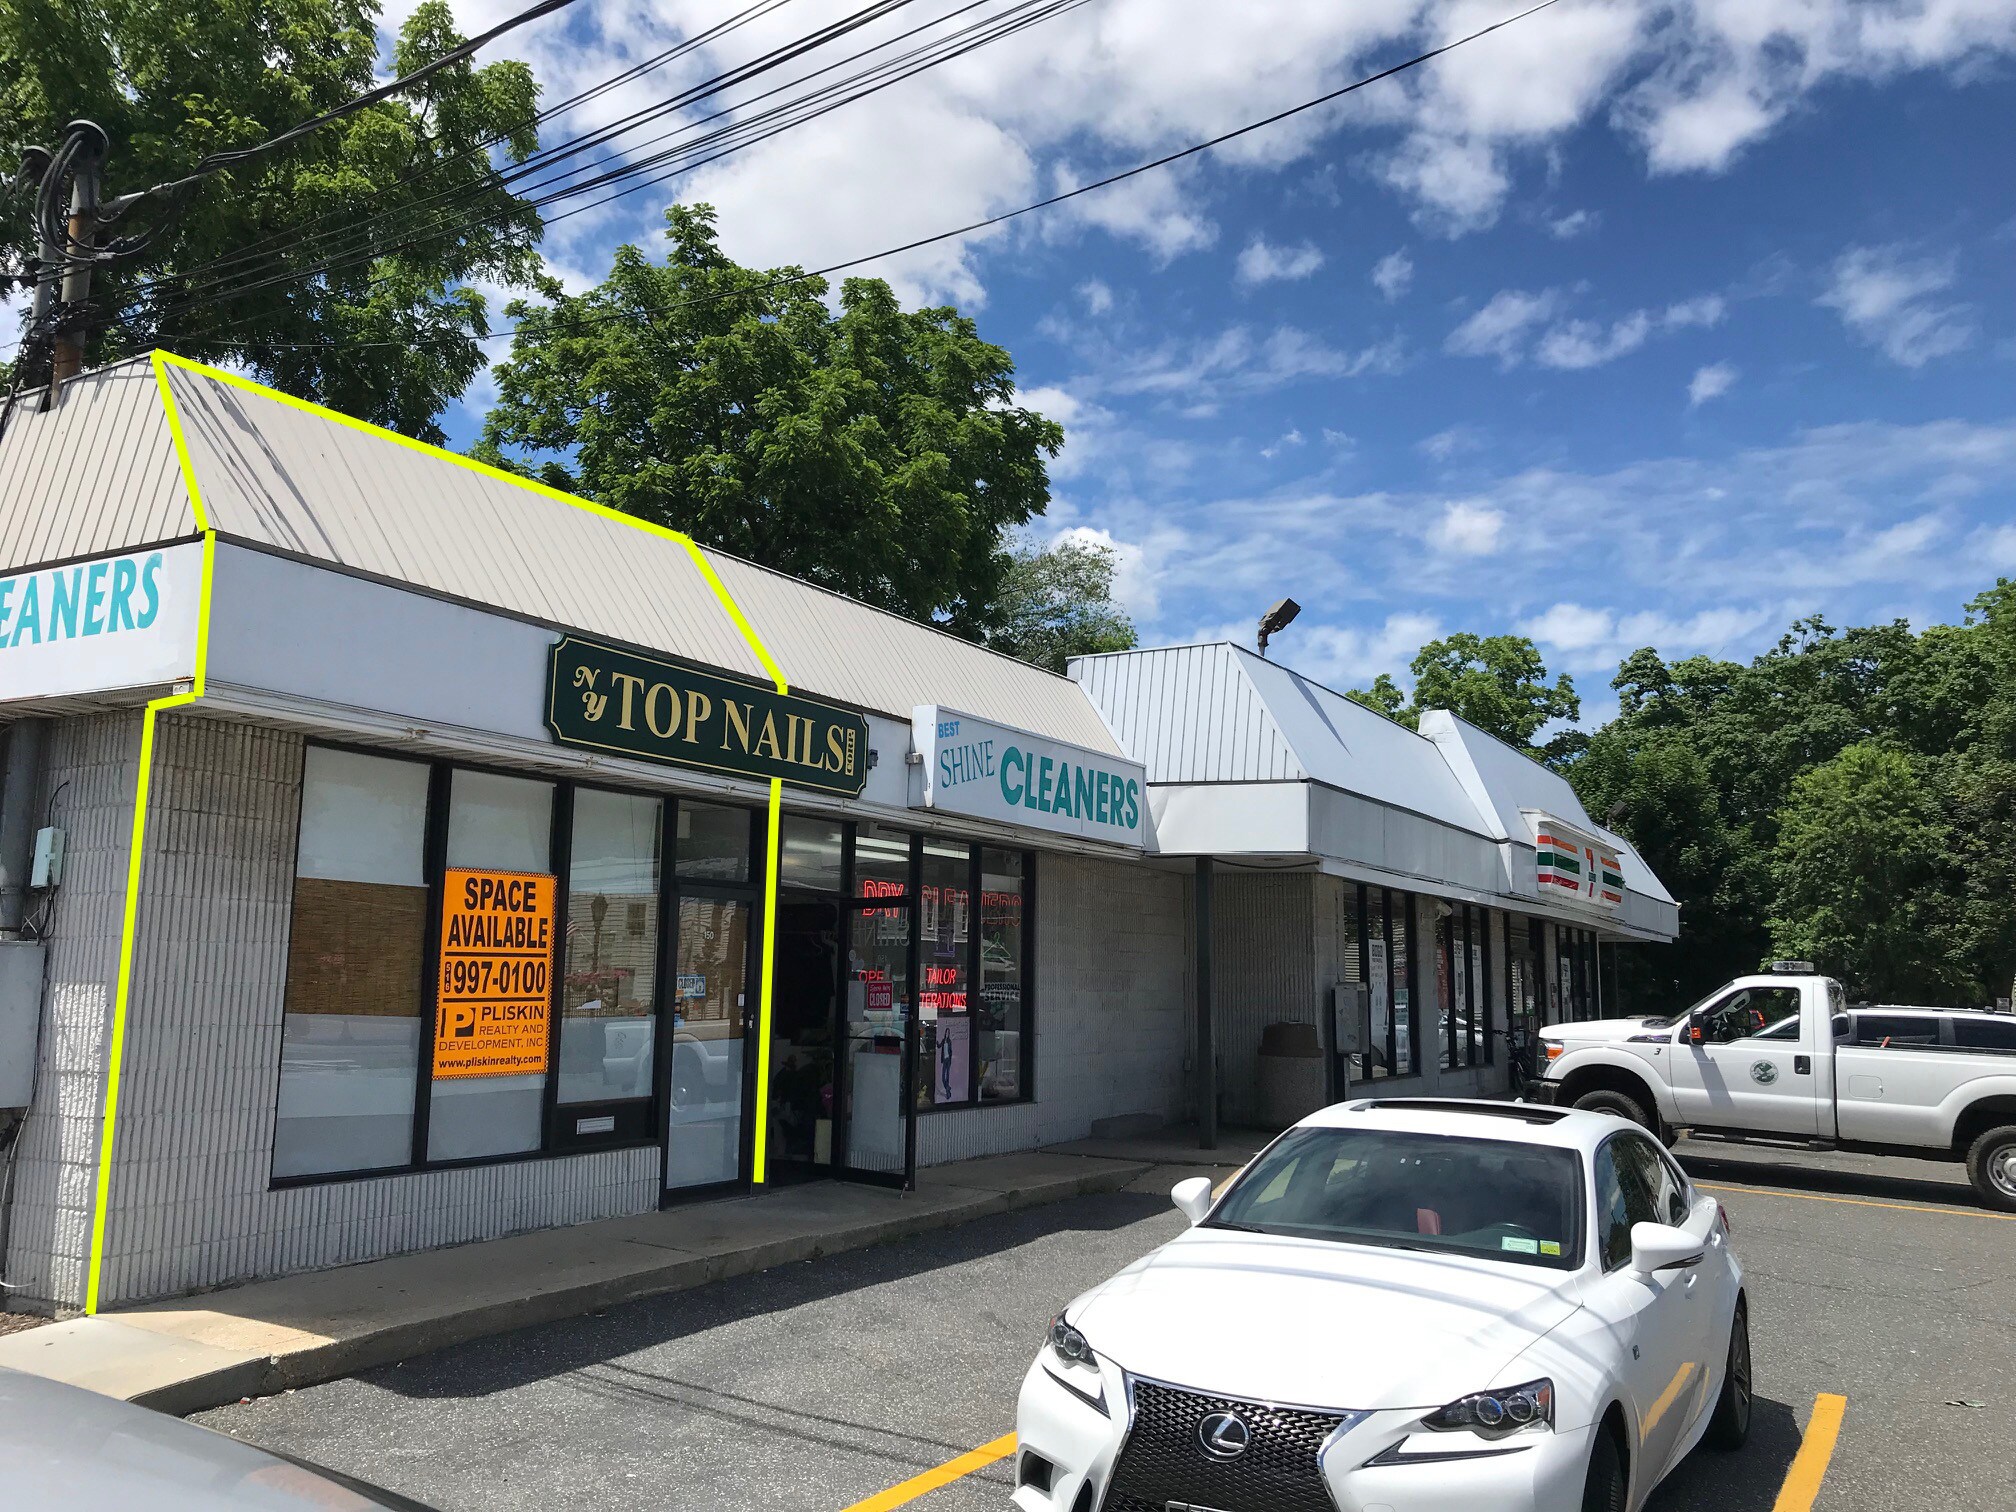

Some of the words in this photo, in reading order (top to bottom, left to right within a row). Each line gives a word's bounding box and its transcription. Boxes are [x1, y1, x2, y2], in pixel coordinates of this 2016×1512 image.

[611, 672, 712, 744] TOP
[720, 699, 845, 773] NAILS
[938, 721, 960, 738] BEST
[940, 740, 995, 789] SHINE
[1000, 746, 1139, 830] CLEANERS
[464, 877, 537, 912] SPACE
[863, 880, 904, 918] DRY
[447, 914, 548, 949] AVAILABLE
[453, 960, 546, 994] 997-0100
[927, 968, 957, 984] TAILOR
[869, 993, 890, 1006] CLOSED
[481, 1006, 544, 1021] PLISKIN
[479, 1025, 518, 1036] REALTY
[522, 1024, 544, 1034] AND
[526, 1038, 543, 1048] INC
[438, 1055, 542, 1069] www.pliskinrealty.com
